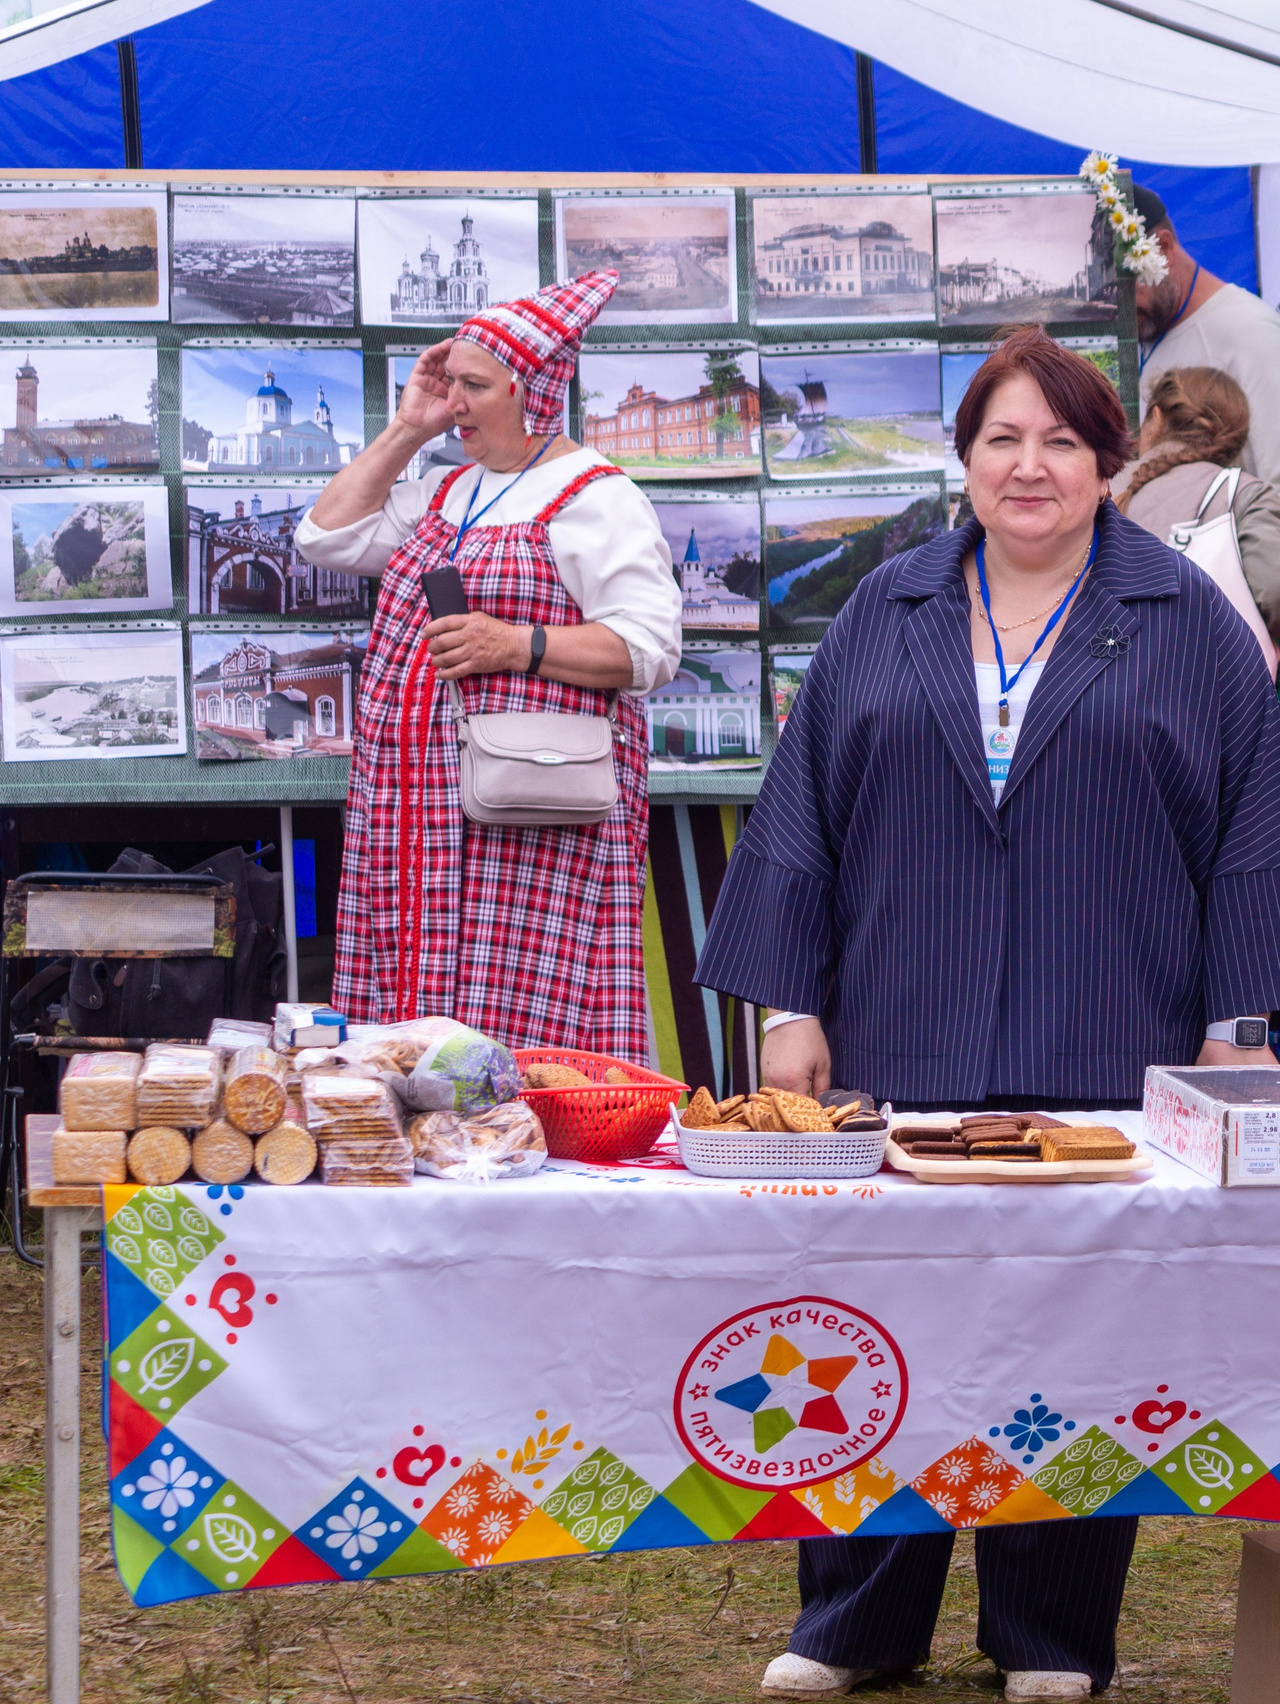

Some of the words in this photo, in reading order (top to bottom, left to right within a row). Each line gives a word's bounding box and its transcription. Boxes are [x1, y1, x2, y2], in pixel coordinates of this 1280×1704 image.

[1265, 1112, 1276, 1120] 2,8
[700, 1321, 762, 1374] знак
[769, 1308, 887, 1369] качества
[690, 1407, 887, 1478] пятизвездочное
